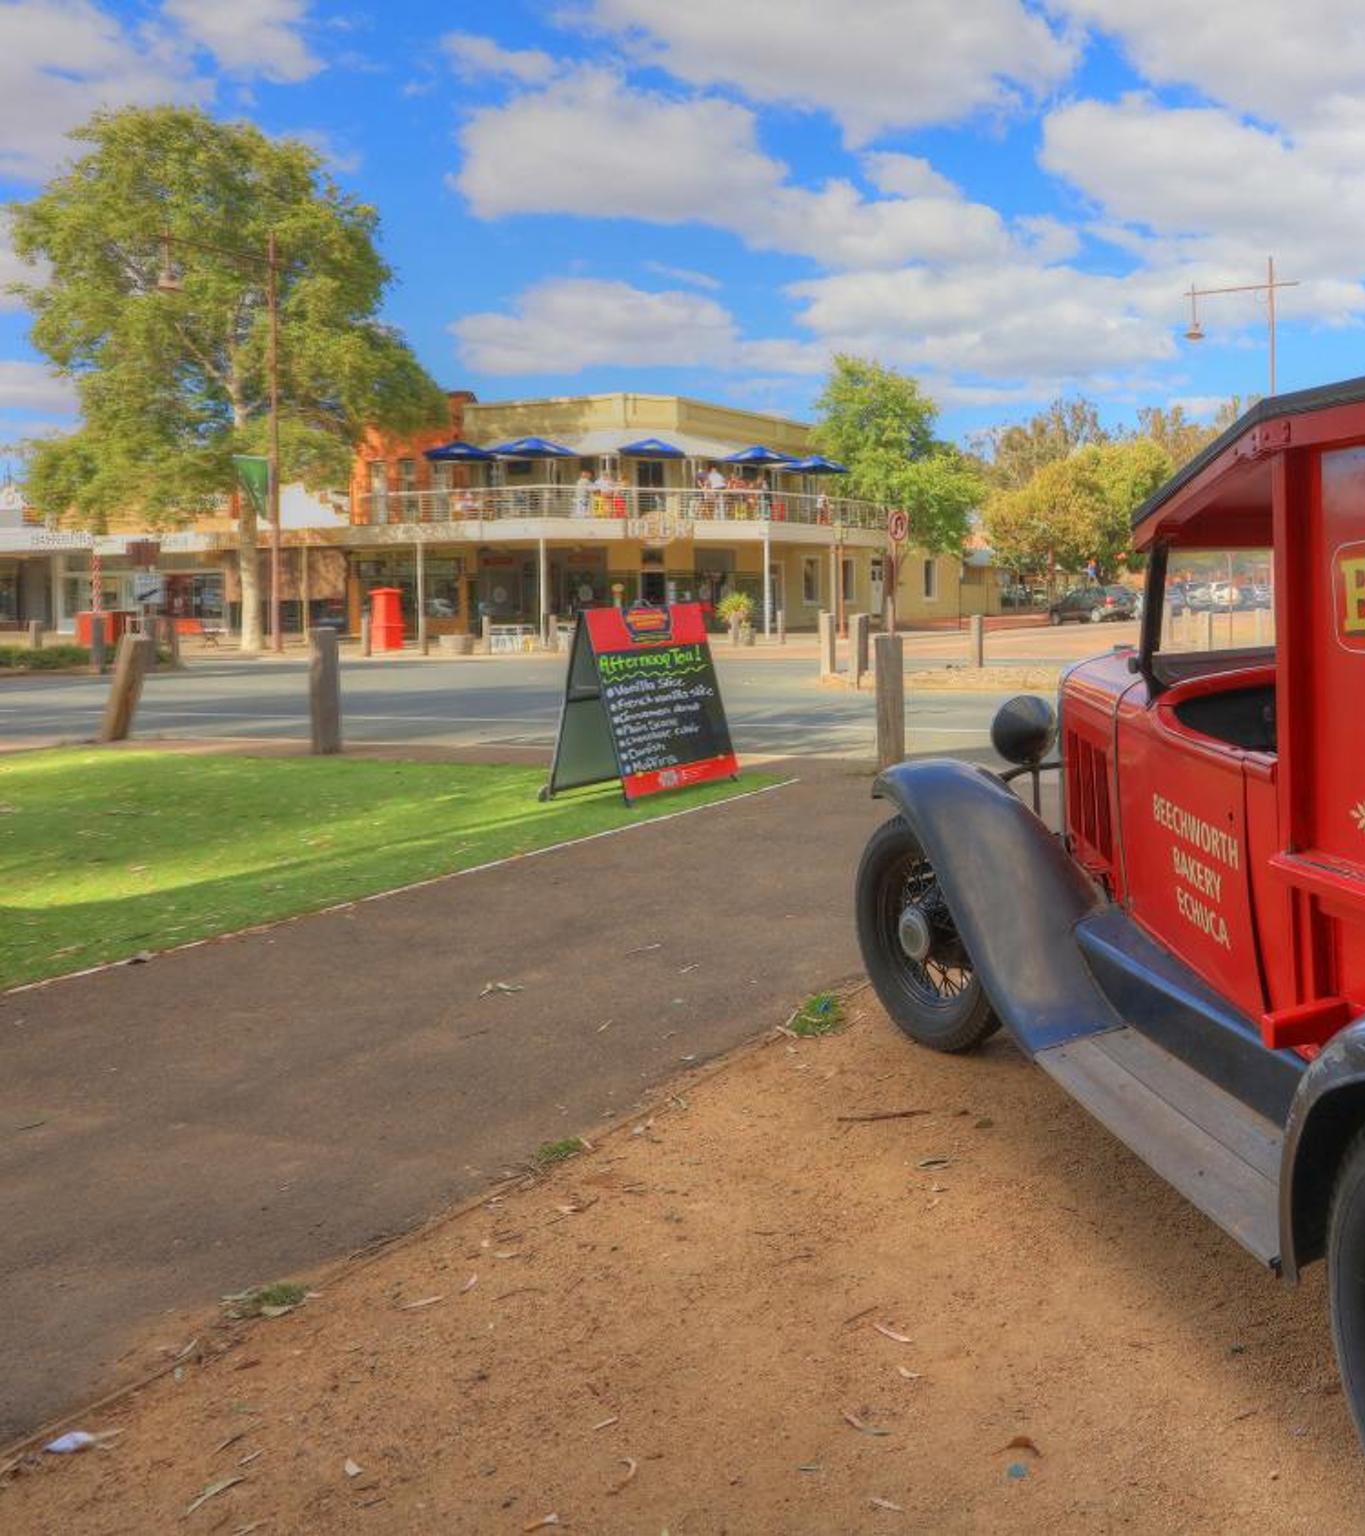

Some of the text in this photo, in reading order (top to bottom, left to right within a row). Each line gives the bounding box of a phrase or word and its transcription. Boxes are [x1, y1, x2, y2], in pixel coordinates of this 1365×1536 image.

[1153, 792, 1239, 870] BEECHWORTH
[1173, 847, 1222, 904] BAKERY
[1176, 886, 1232, 951] ECHUCA
